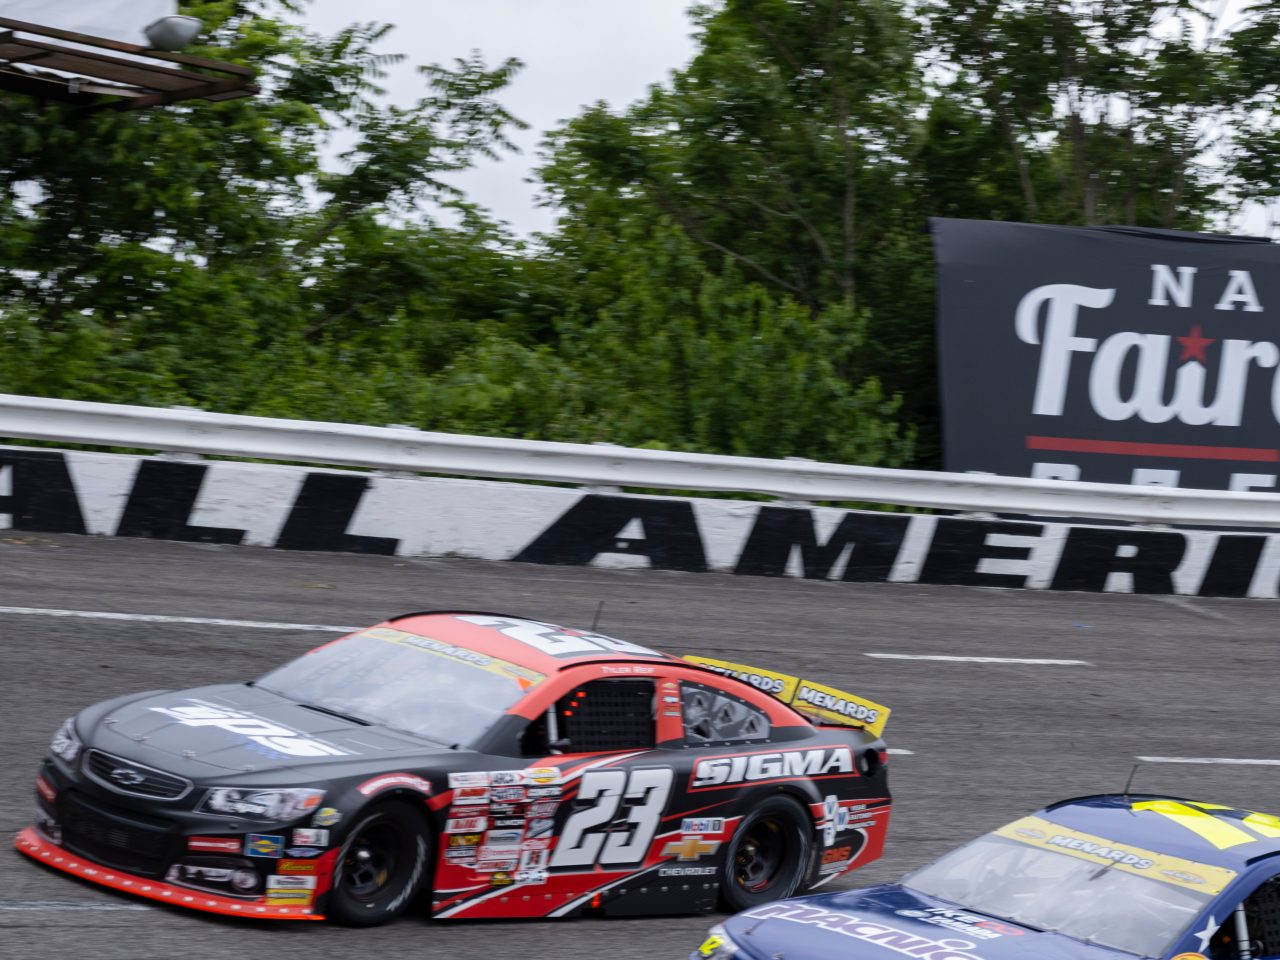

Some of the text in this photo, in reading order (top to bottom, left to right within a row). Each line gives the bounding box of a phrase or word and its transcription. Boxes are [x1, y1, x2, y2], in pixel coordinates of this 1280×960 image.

[400, 636, 492, 667] MENARDS
[798, 685, 880, 724] MENARDS
[692, 747, 854, 787] SIGMA
[549, 768, 675, 868] 23
[682, 819, 711, 833] Mobil
[1047, 834, 1155, 870] MENARDS
[658, 866, 718, 877] CHEVROLET
